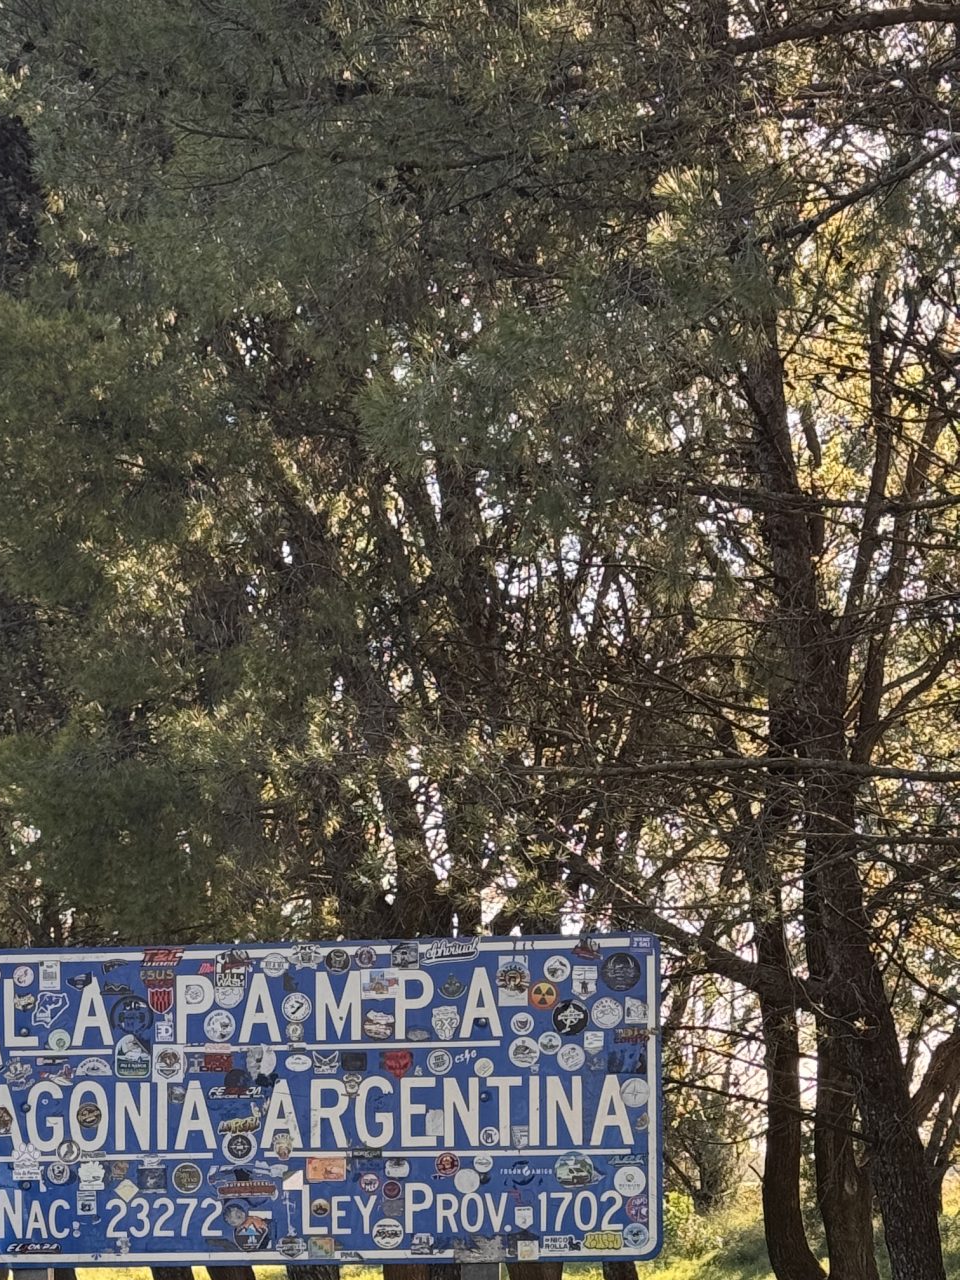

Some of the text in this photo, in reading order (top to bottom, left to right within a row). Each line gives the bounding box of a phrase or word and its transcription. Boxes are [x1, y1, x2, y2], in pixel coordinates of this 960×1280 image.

[3, 967, 503, 1047] LA PAMPA
[260, 1074, 635, 1149] ARGENTINA
[105, 1197, 223, 1238] 23272
[538, 1190, 624, 1232] 1702
